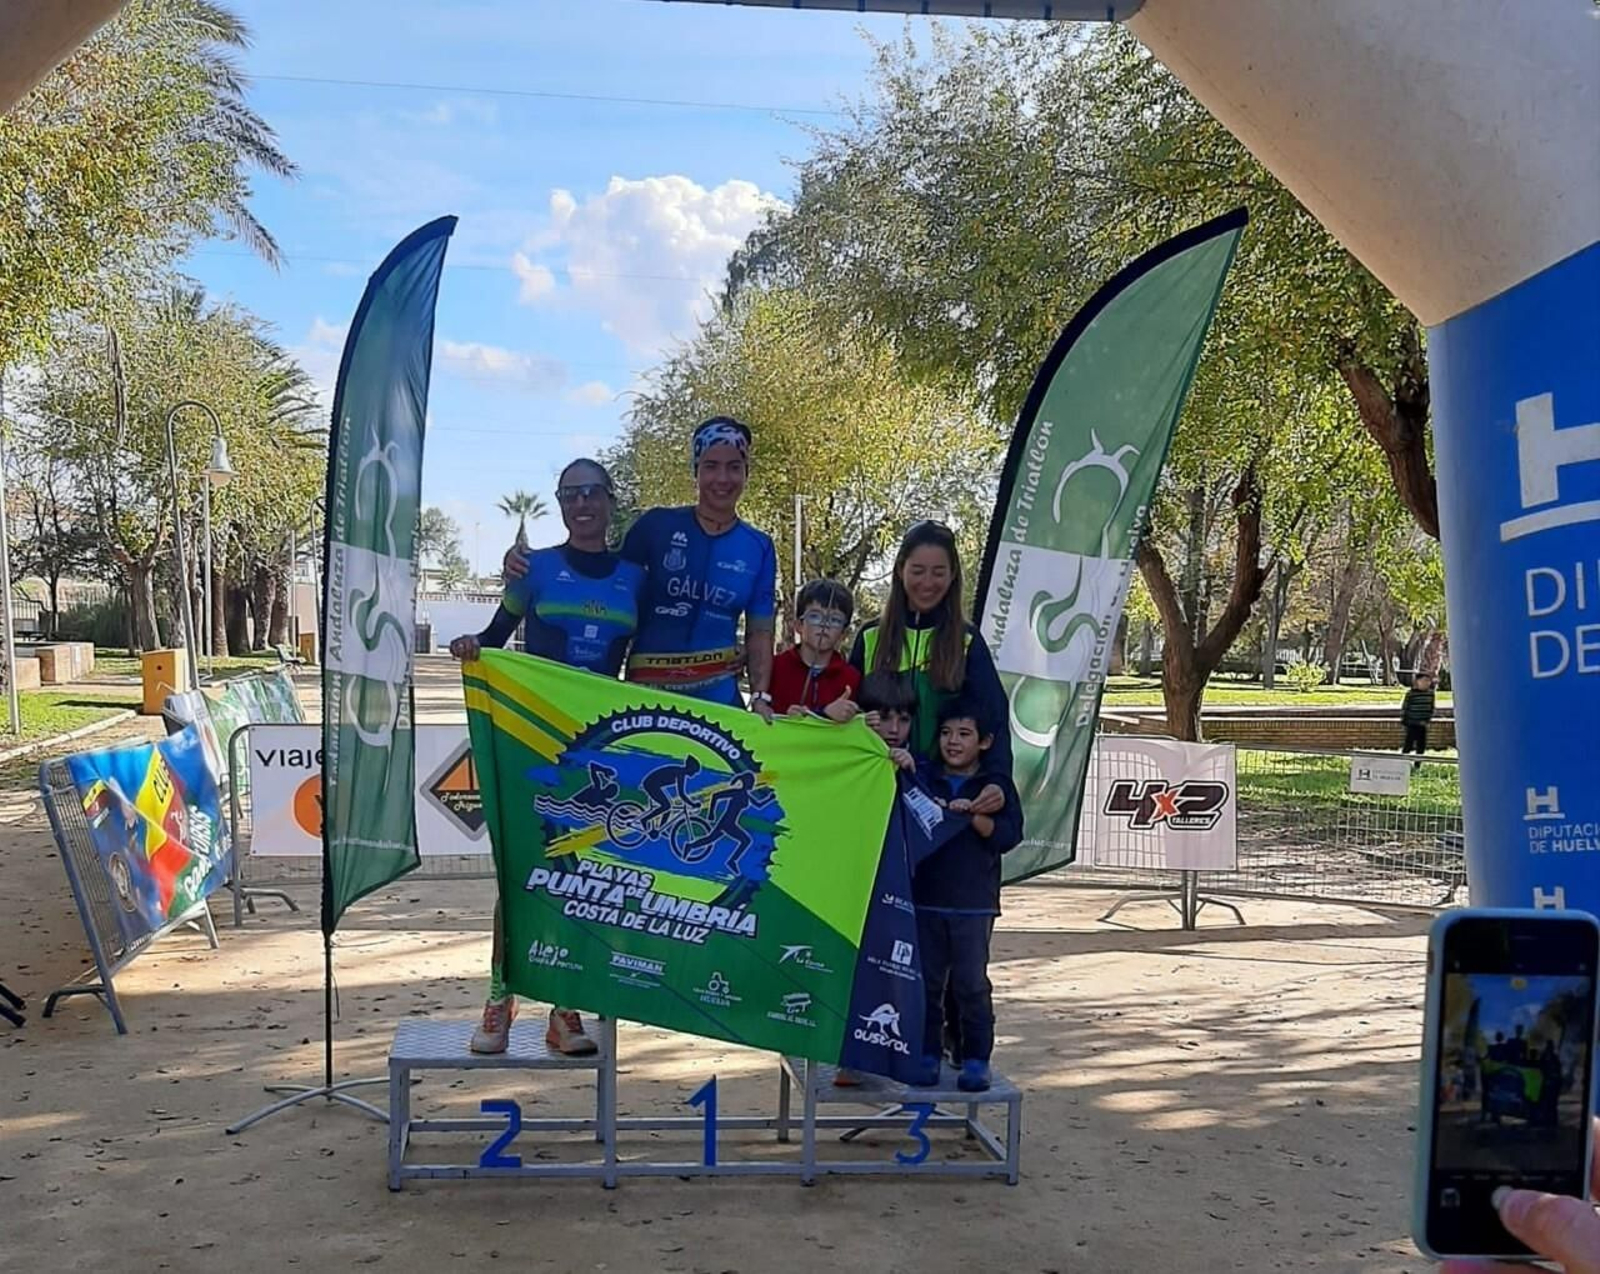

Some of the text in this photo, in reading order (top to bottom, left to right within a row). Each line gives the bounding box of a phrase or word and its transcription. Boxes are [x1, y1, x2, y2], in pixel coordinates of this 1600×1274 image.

[1016, 420, 1054, 511] Triatlón
[1011, 517, 1030, 543] de
[667, 575, 737, 608] GÁLVEZ
[1526, 559, 1600, 616] DI
[611, 715, 741, 760] CLUB DEPORTIVO
[1529, 823, 1600, 840] DIPUTACI
[1529, 840, 1548, 854] DE
[577, 860, 654, 888] PLAYAS
[527, 868, 757, 936] PUNTA DE UMBRÍA
[564, 900, 709, 943] COSTA DE LA LUZ
[528, 940, 569, 966] Alejo
[612, 954, 664, 973] PAVIMAN
[479, 1073, 937, 1168] 2 1 3
